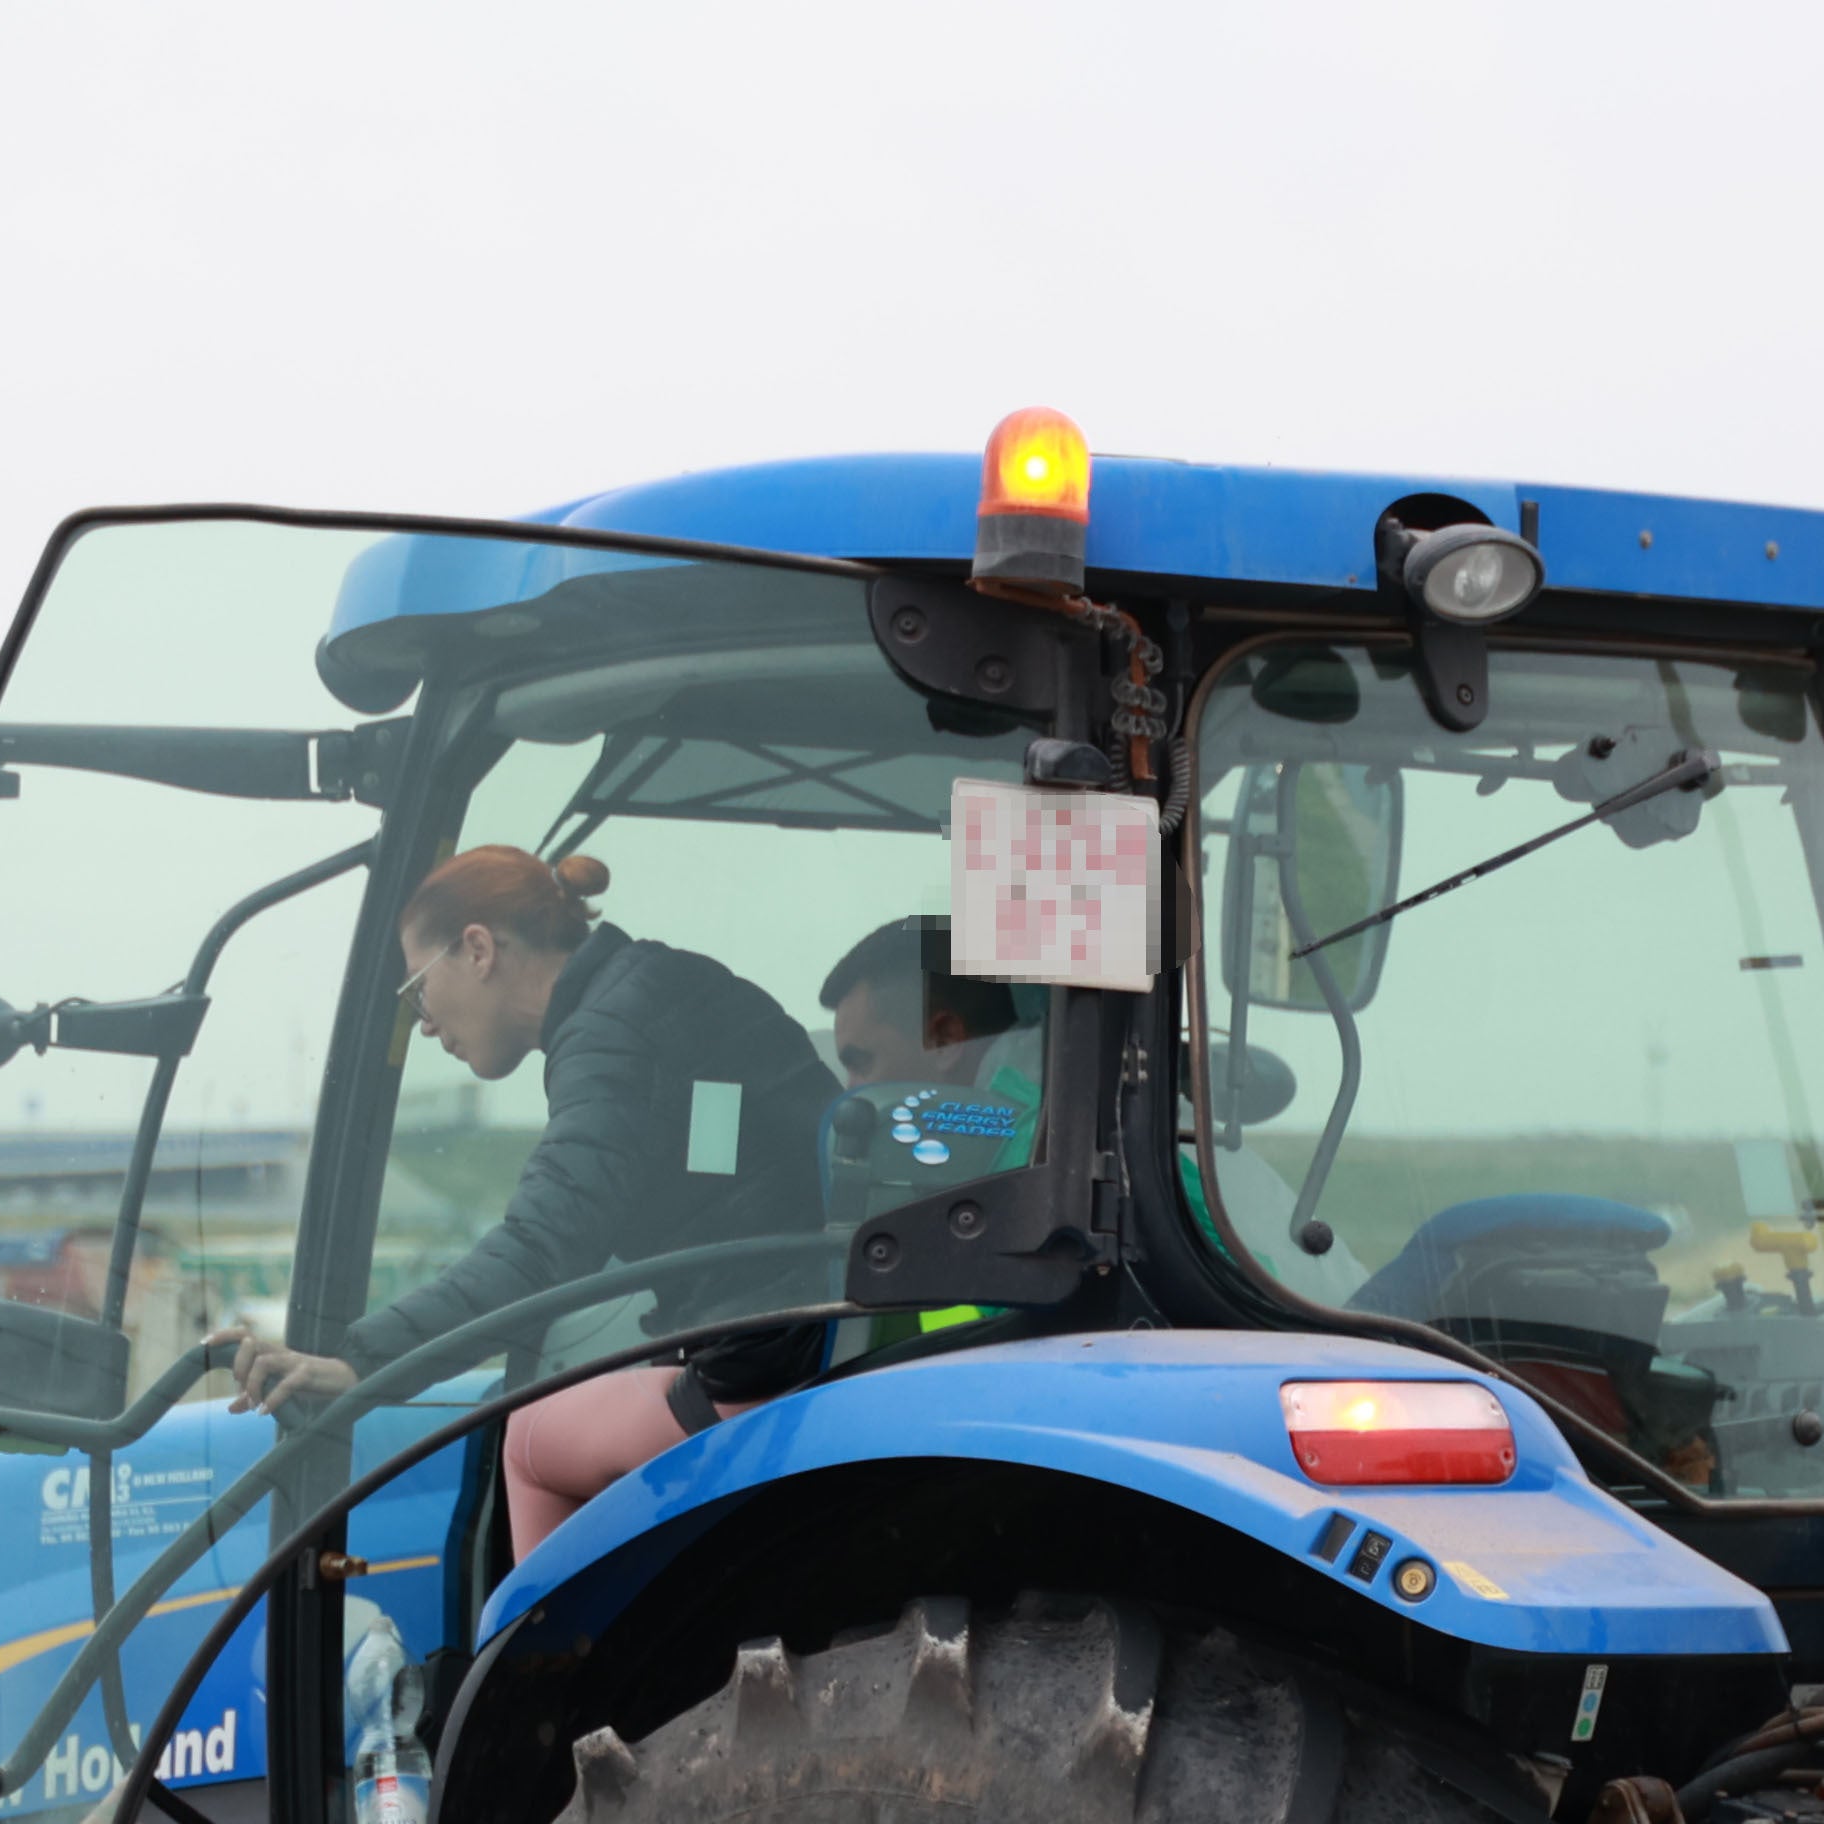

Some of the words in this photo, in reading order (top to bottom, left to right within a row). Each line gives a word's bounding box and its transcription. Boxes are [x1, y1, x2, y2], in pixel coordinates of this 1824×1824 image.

[939, 1101, 1016, 1118] CLEAN
[921, 1111, 1016, 1128] ENERGY
[926, 1121, 1017, 1139] LEADER
